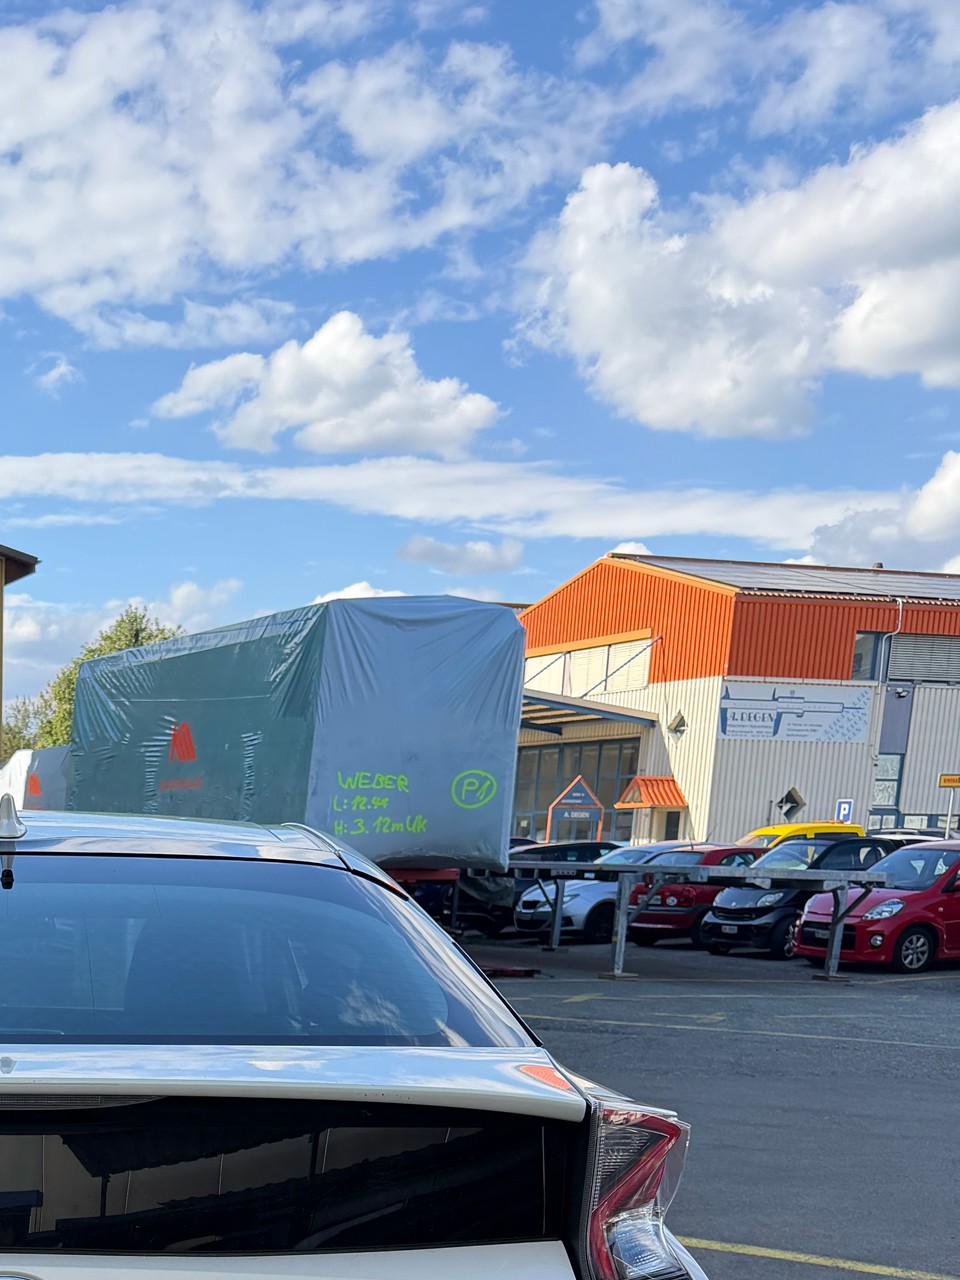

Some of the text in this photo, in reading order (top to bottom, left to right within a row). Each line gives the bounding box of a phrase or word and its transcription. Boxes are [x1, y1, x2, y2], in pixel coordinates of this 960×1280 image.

[741, 711, 774, 722] DEGEN
[337, 771, 409, 793] WEBER
[840, 803, 849, 820] P
